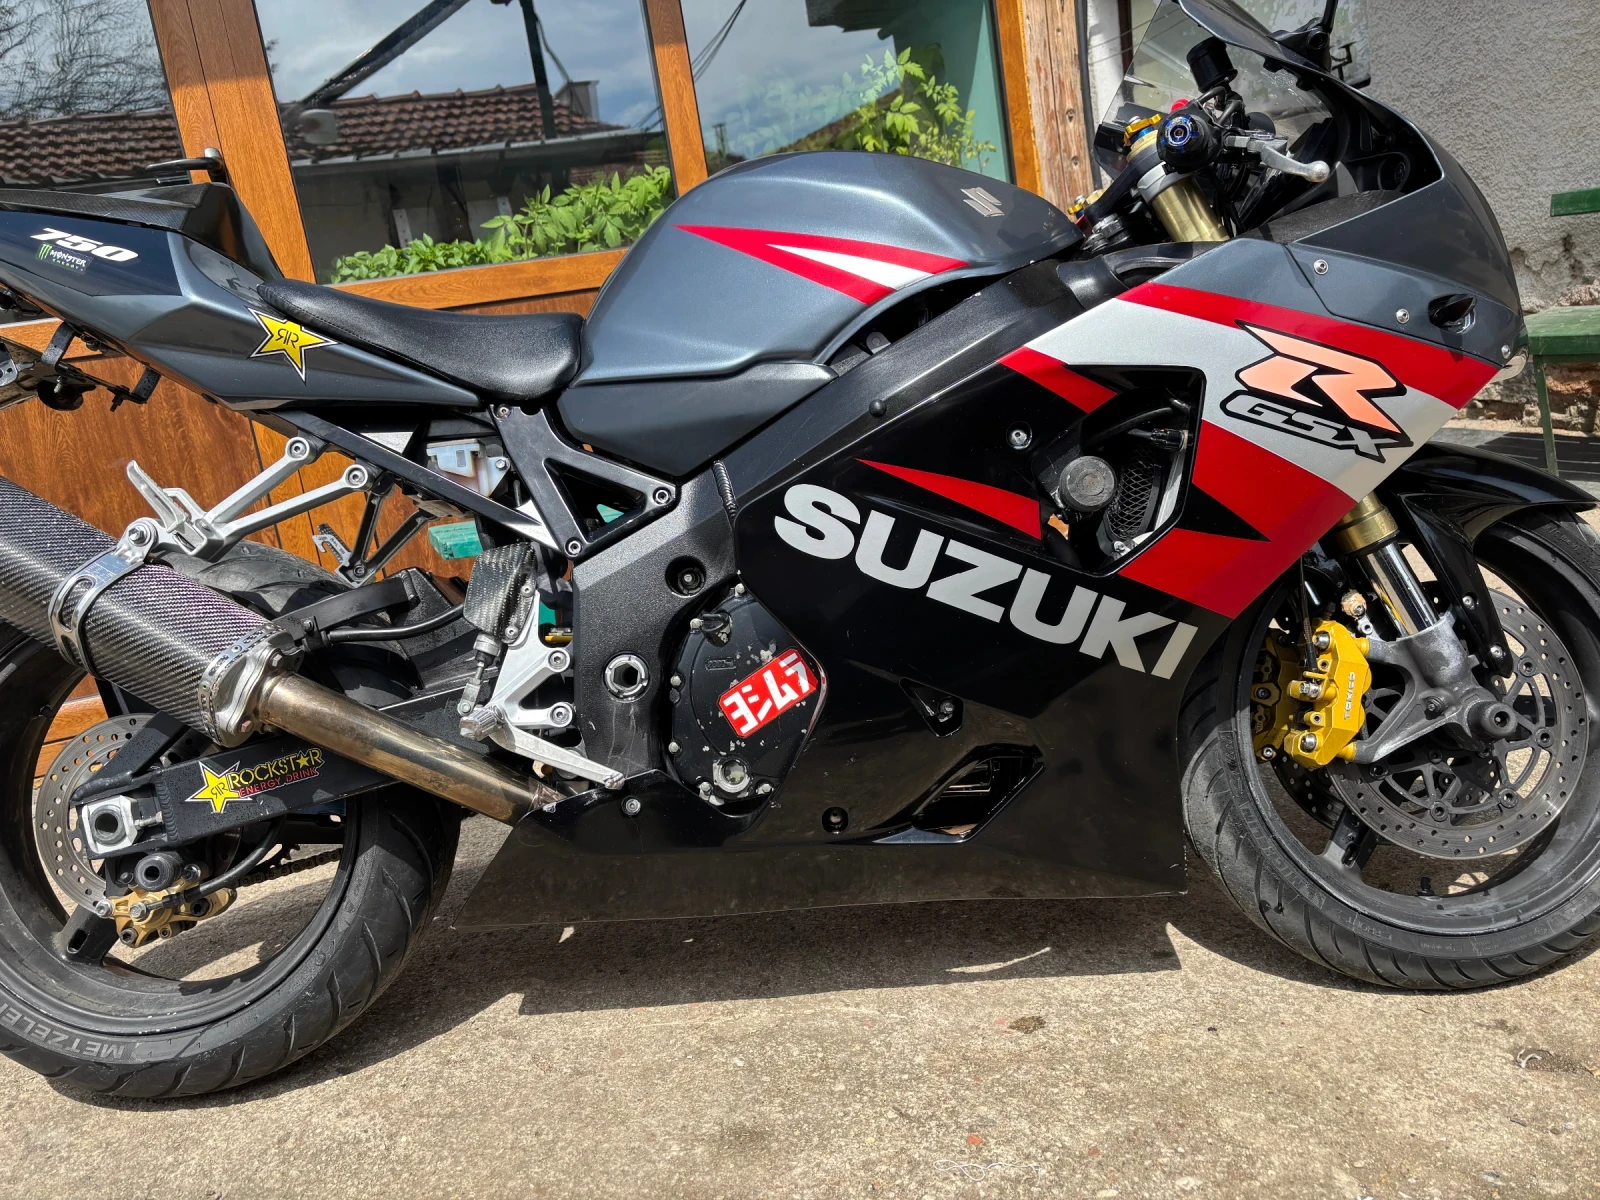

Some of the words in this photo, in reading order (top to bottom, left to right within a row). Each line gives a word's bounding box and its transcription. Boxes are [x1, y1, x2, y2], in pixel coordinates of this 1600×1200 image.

[30, 227, 139, 262] 750
[49, 248, 87, 268] MONSTER
[1220, 390, 1408, 463] GSX
[774, 484, 1199, 680] SUZUKI
[723, 652, 811, 734] ヨシムラ
[239, 776, 282, 798] ENERGY
[285, 767, 319, 783] DRINK
